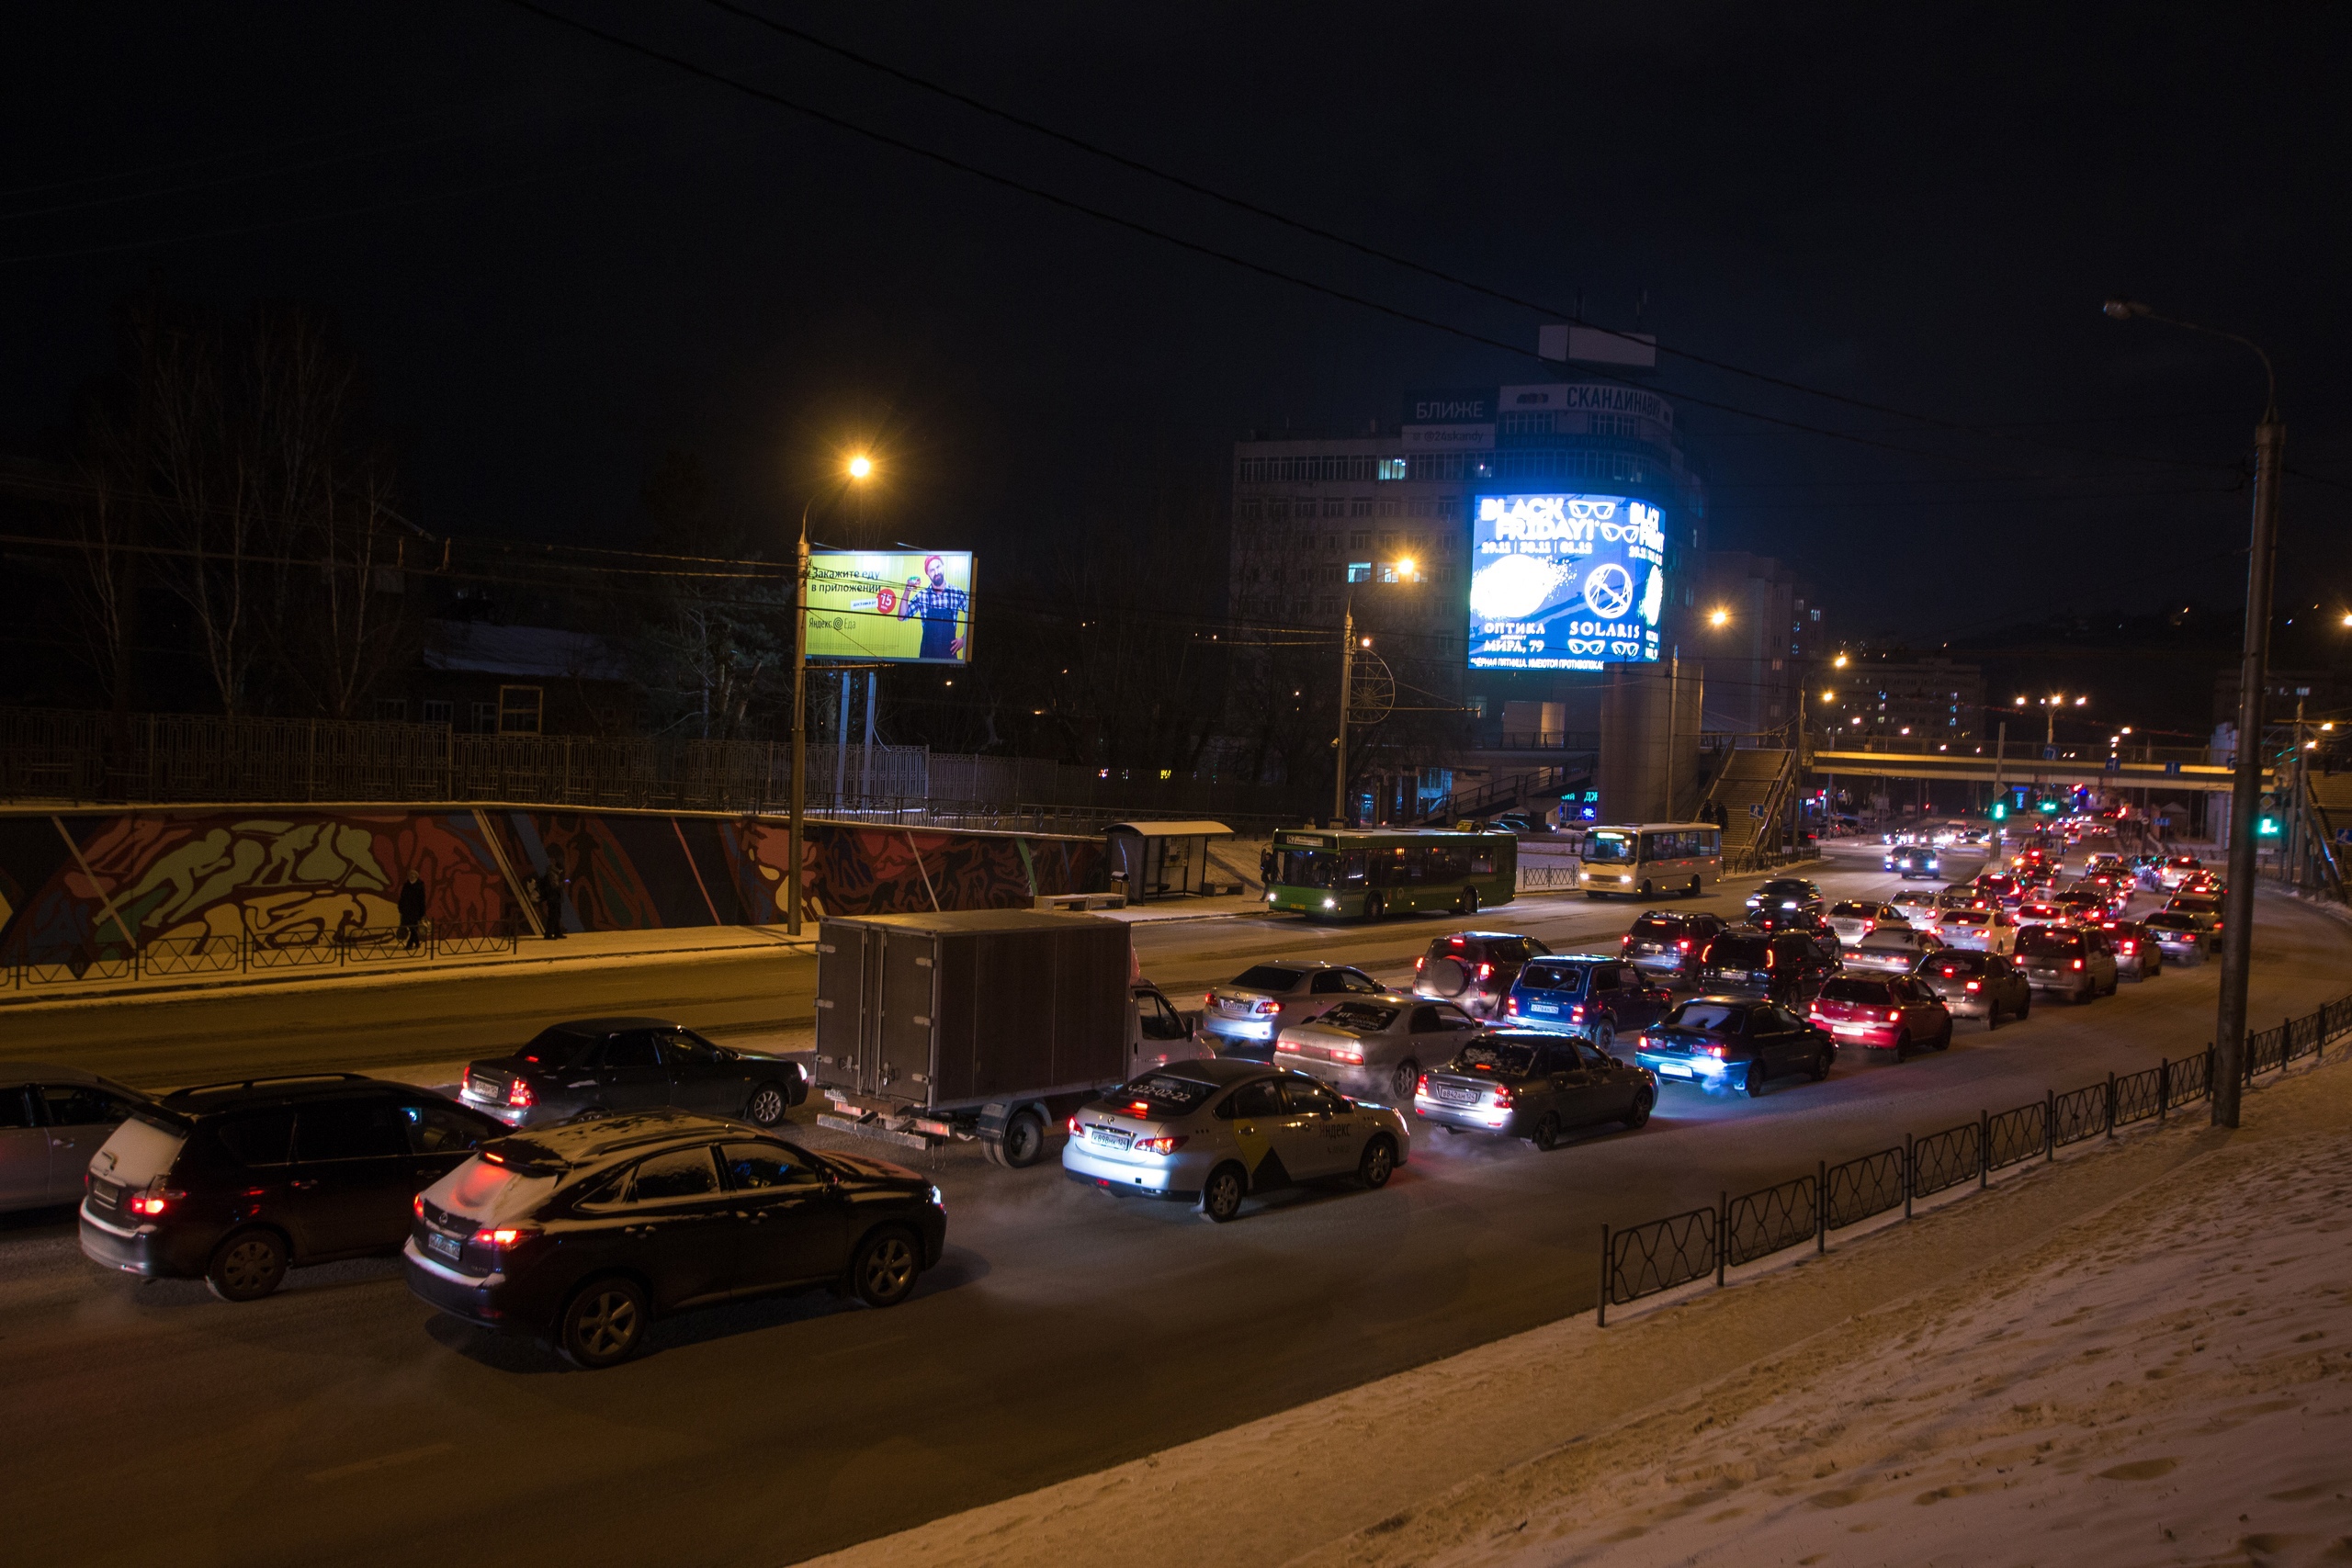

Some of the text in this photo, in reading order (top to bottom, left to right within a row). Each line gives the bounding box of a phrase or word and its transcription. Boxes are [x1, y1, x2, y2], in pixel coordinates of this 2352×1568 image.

[1416, 400, 1485, 419] БЛИЖЕ
[1481, 498, 1565, 521] BLACK
[813, 568, 881, 580] Закажите еду
[819, 583, 881, 593] приложении
[880, 593, 892, 606] 15
[808, 617, 855, 629] Яндекс Еда
[1484, 623, 1545, 635] ОПТИКА
[1569, 621, 1640, 638] SOLARIS
[1483, 640, 1545, 654] МИРА, 79
[1287, 835, 1295, 844] 87
[1133, 1084, 1192, 1102] 222-02-22
[1317, 1121, 1351, 1139] Яндекс
